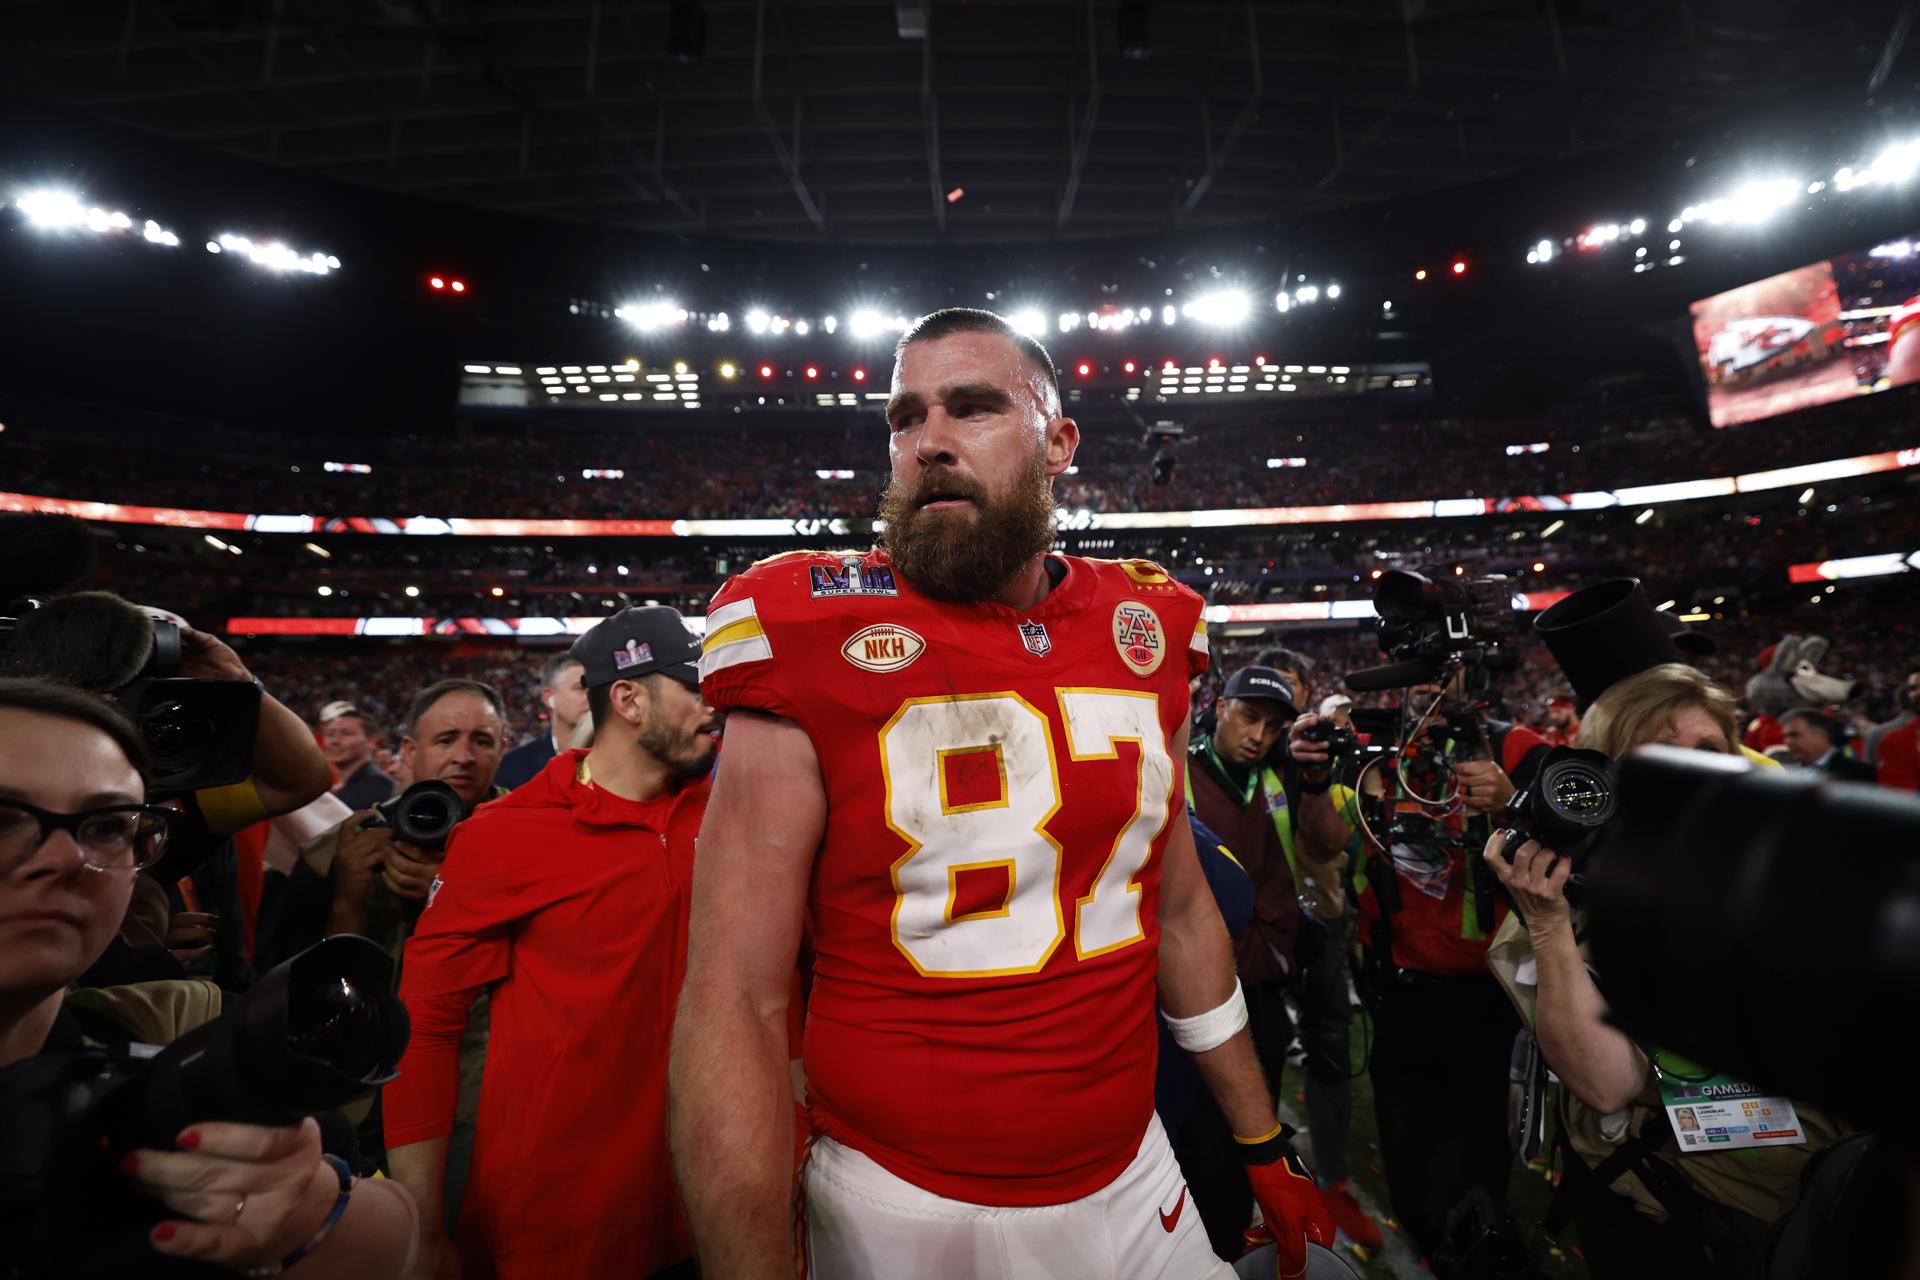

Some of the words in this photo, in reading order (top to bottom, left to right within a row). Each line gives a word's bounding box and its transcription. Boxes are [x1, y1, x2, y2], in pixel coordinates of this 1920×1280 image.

[1027, 635, 1048, 651] NFL
[1119, 608, 1158, 648] A
[864, 637, 906, 661] NKH
[878, 686, 1175, 978] 87
